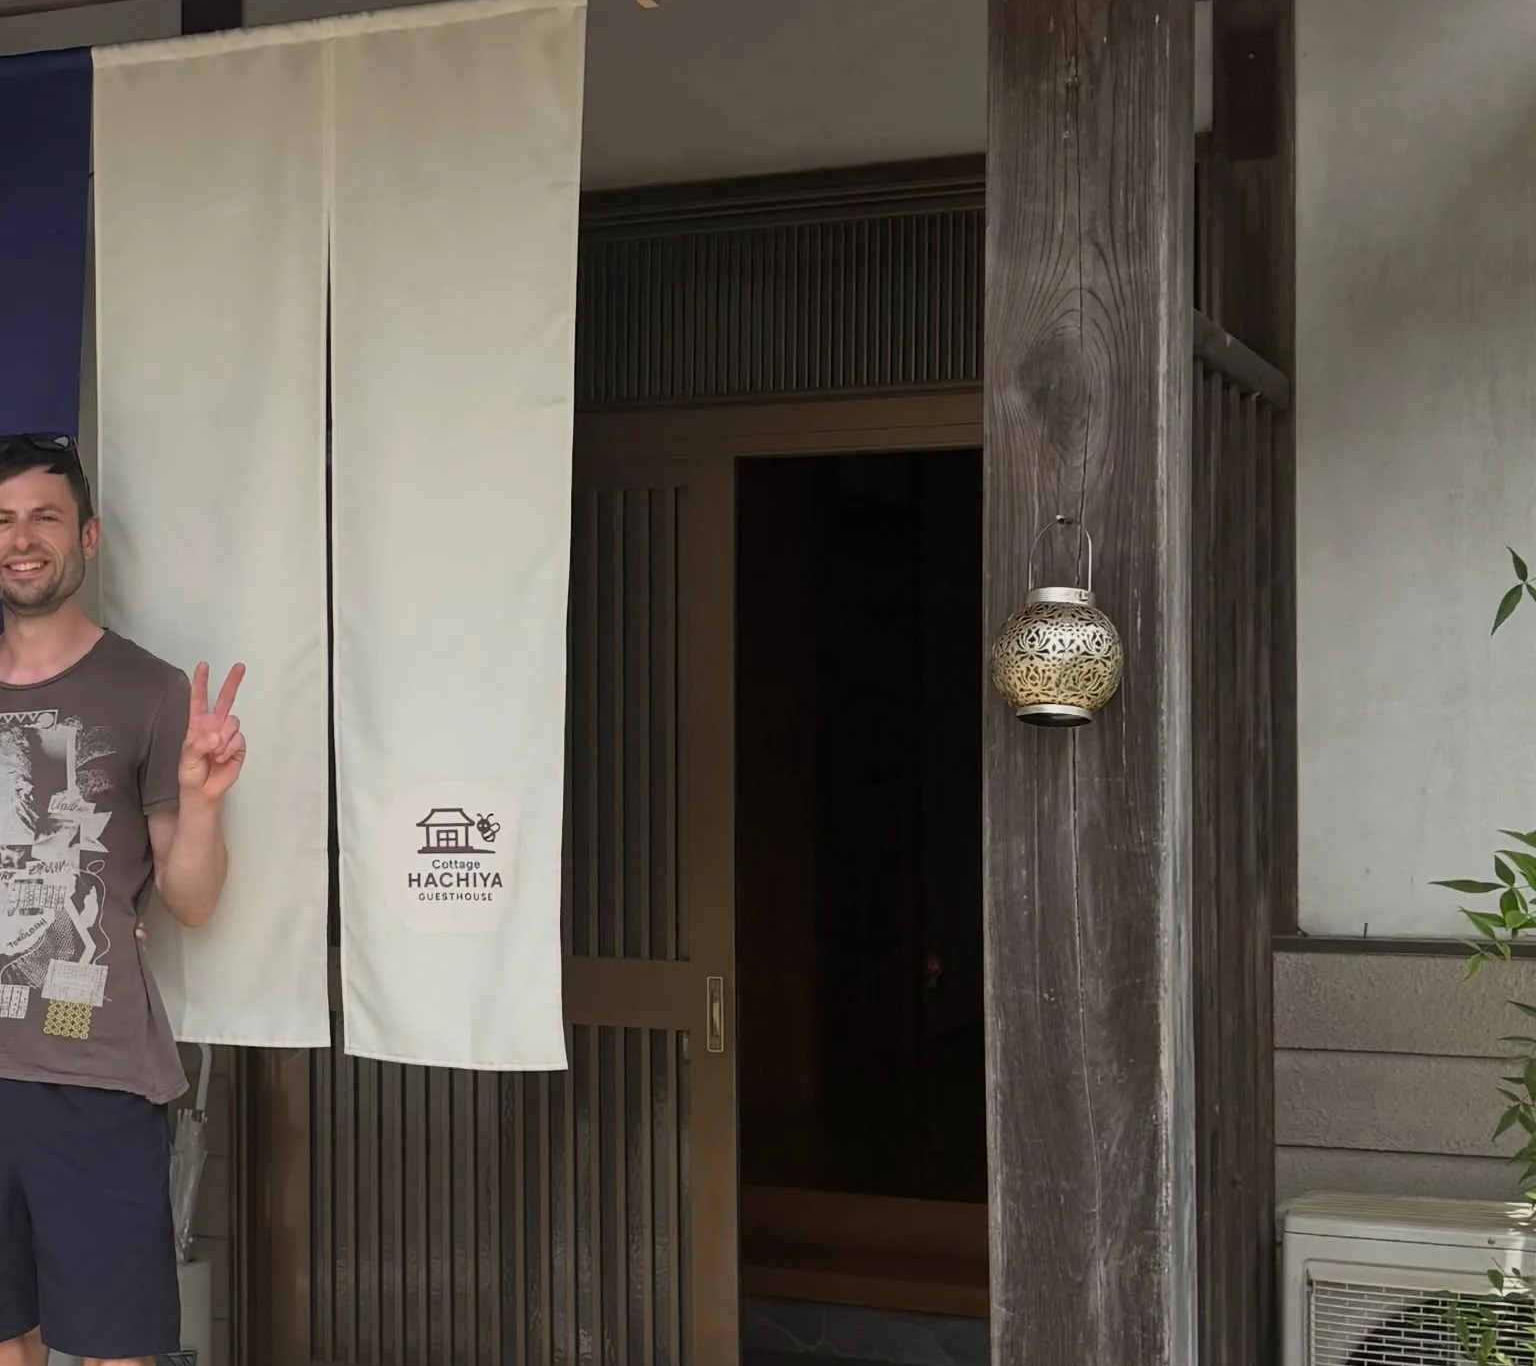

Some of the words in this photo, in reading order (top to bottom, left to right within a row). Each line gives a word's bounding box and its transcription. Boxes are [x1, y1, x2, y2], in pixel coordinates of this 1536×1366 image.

[431, 859, 481, 871] Cottage
[408, 872, 503, 888] HACHIYA
[418, 892, 493, 901] GUESTHOUSE
